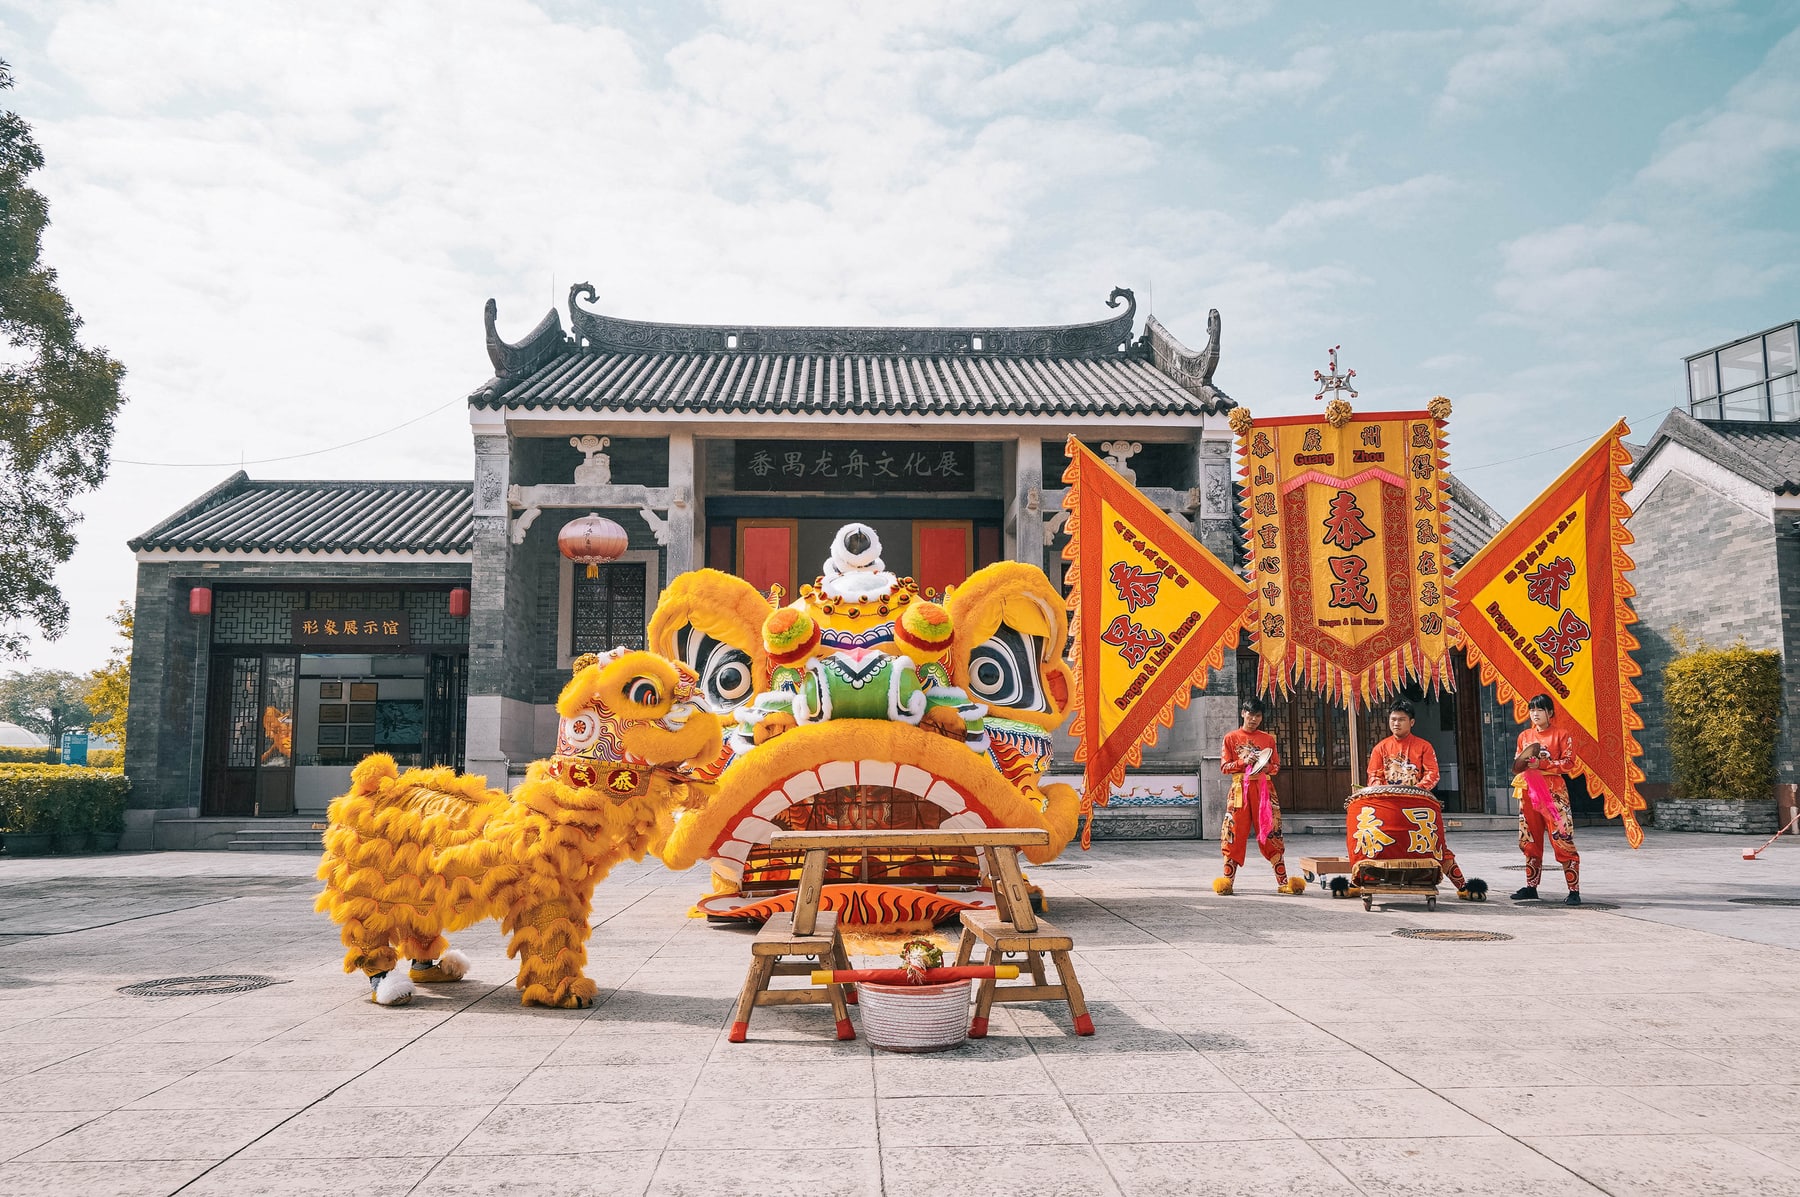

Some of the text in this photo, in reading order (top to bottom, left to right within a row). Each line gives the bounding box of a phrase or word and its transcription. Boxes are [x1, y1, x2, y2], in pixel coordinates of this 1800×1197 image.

[748, 449, 965, 478] 番禺龙舟文化展
[1294, 450, 1385, 466] Guang Zhou
[302, 619, 400, 635] 形象展示馆
[1114, 610, 1201, 711] Dragon & Lion Dance
[1486, 601, 1571, 699] Dragon & Lion Dance
[1353, 806, 1444, 861] 泰晟
